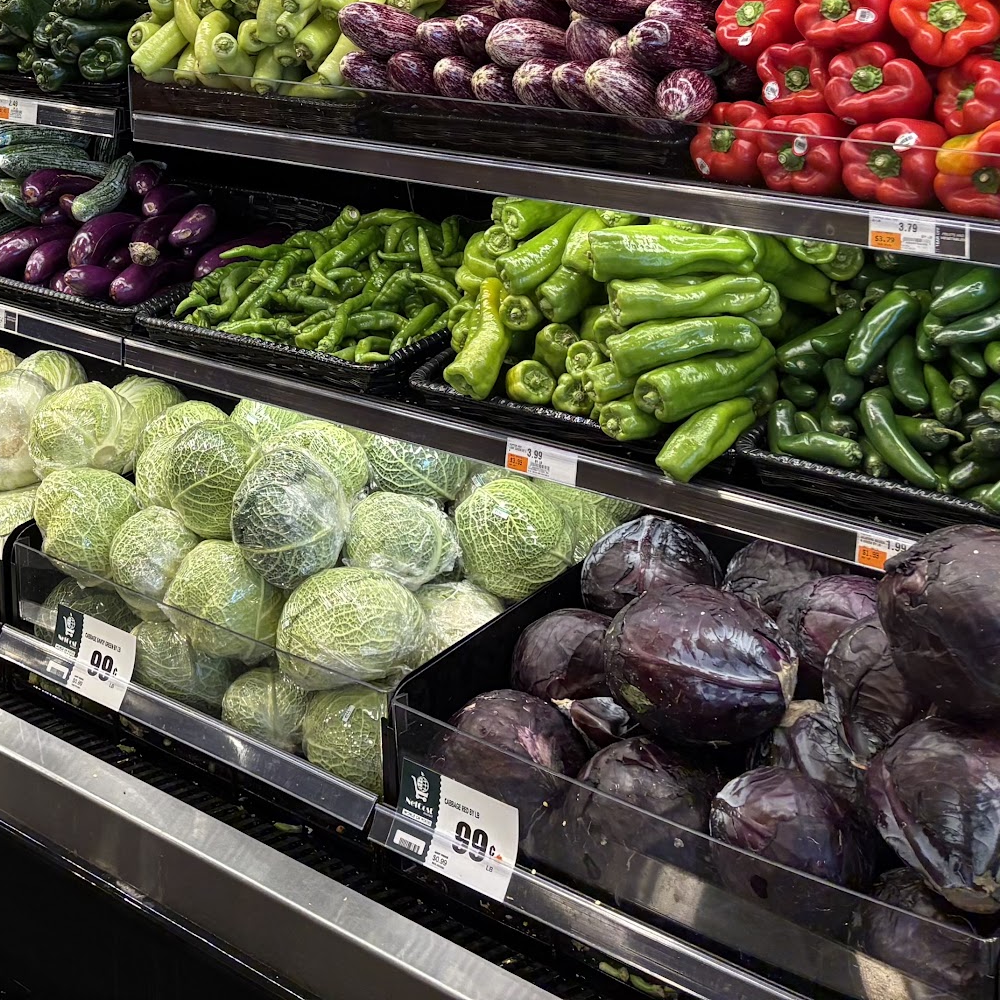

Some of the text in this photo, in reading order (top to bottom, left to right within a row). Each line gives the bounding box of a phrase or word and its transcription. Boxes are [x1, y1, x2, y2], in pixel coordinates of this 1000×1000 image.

[898, 222, 918, 232] 3.79
[874, 235, 895, 243] $3.79
[526, 448, 542, 460] 3.99
[886, 540, 907, 552] 1.99
[444, 798, 461, 811] CABBAGE
[461, 804, 469, 814] RED
[474, 810, 480, 820] LB
[432, 854, 448, 866] $0.99
[486, 864, 494, 873] LB
